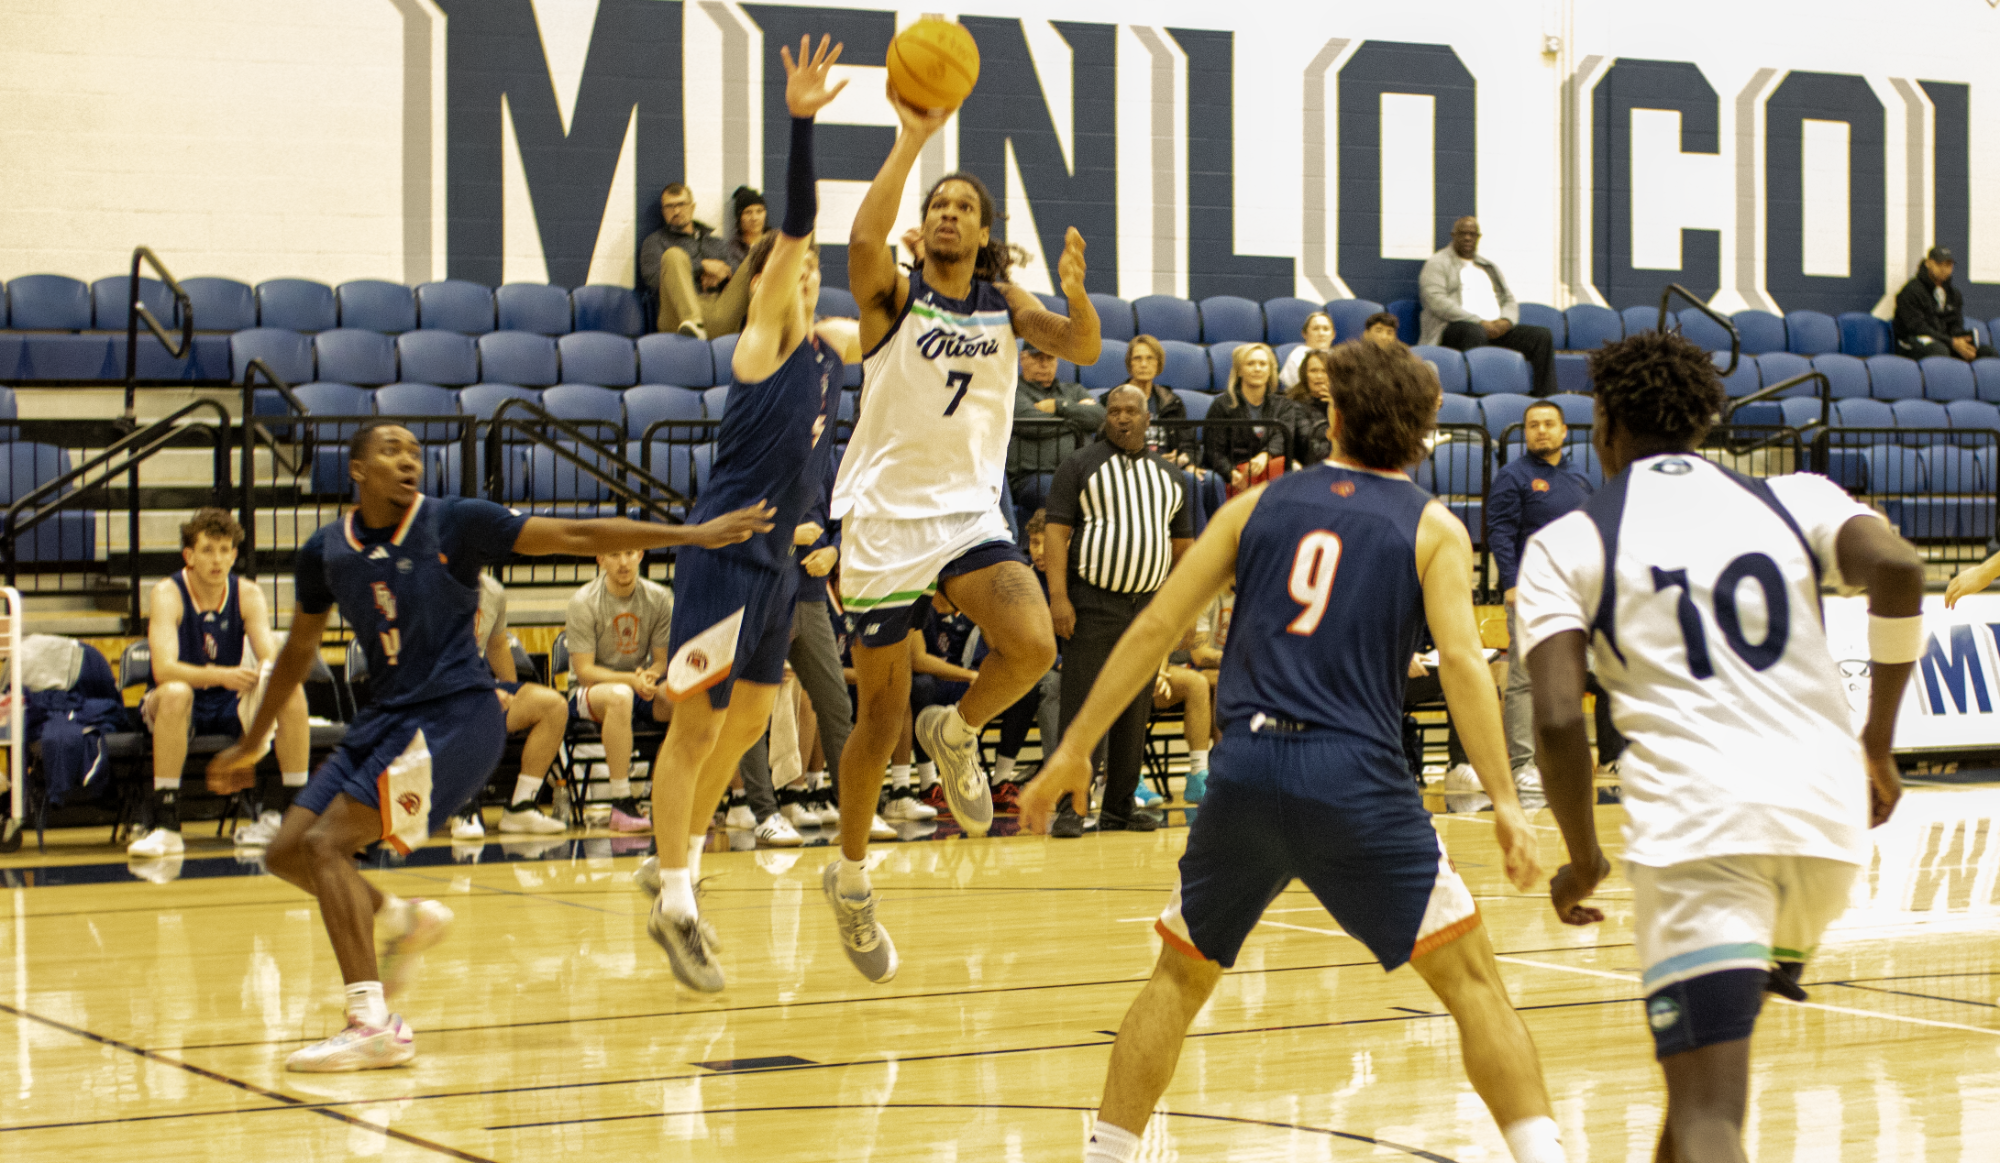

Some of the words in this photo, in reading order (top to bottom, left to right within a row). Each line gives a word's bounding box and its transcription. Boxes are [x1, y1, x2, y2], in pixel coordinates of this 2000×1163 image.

[446, 0, 1477, 302] MENLO
[943, 370, 973, 417] 7
[1286, 529, 1343, 637] 9
[1651, 552, 1790, 680] 10
[1919, 622, 2000, 716] M
